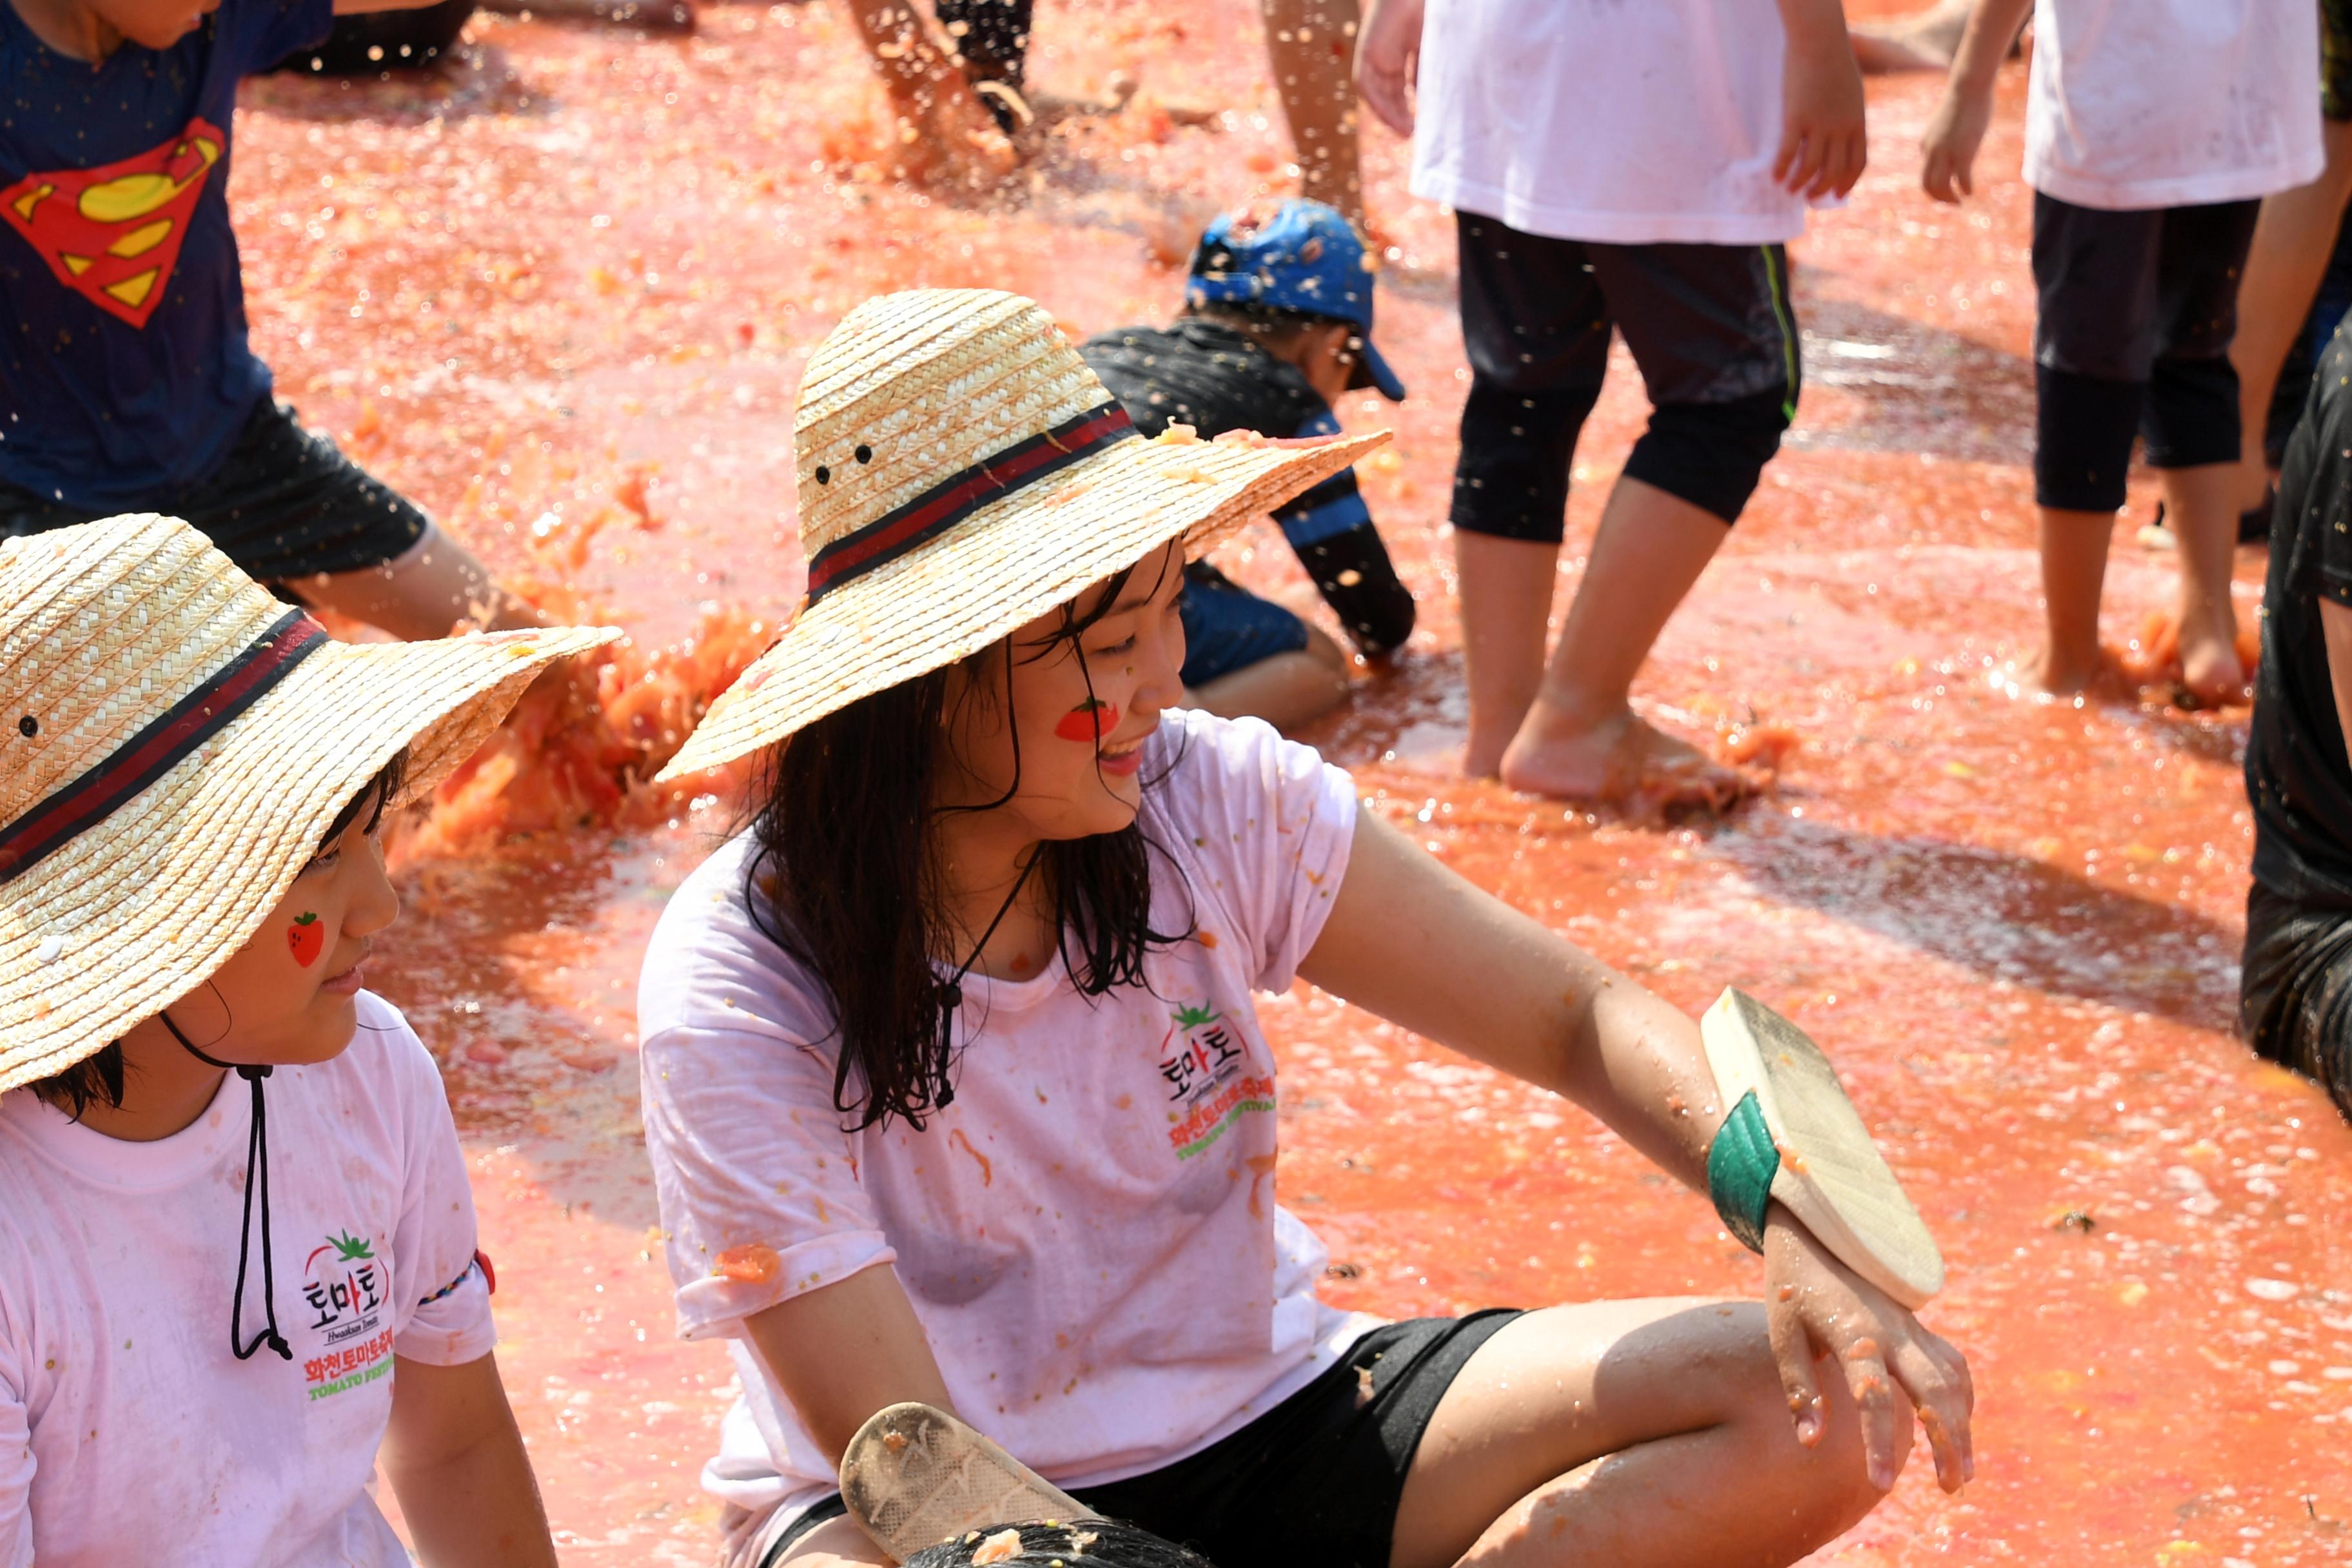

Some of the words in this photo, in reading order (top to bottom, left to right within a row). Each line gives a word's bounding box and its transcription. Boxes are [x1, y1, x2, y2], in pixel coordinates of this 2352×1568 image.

[1159, 1026, 1241, 1101] 토마토
[302, 1264, 379, 1329] 토마토
[304, 1324, 393, 1382] 화천토마토축제
[309, 1373, 363, 1401] TOMATO
